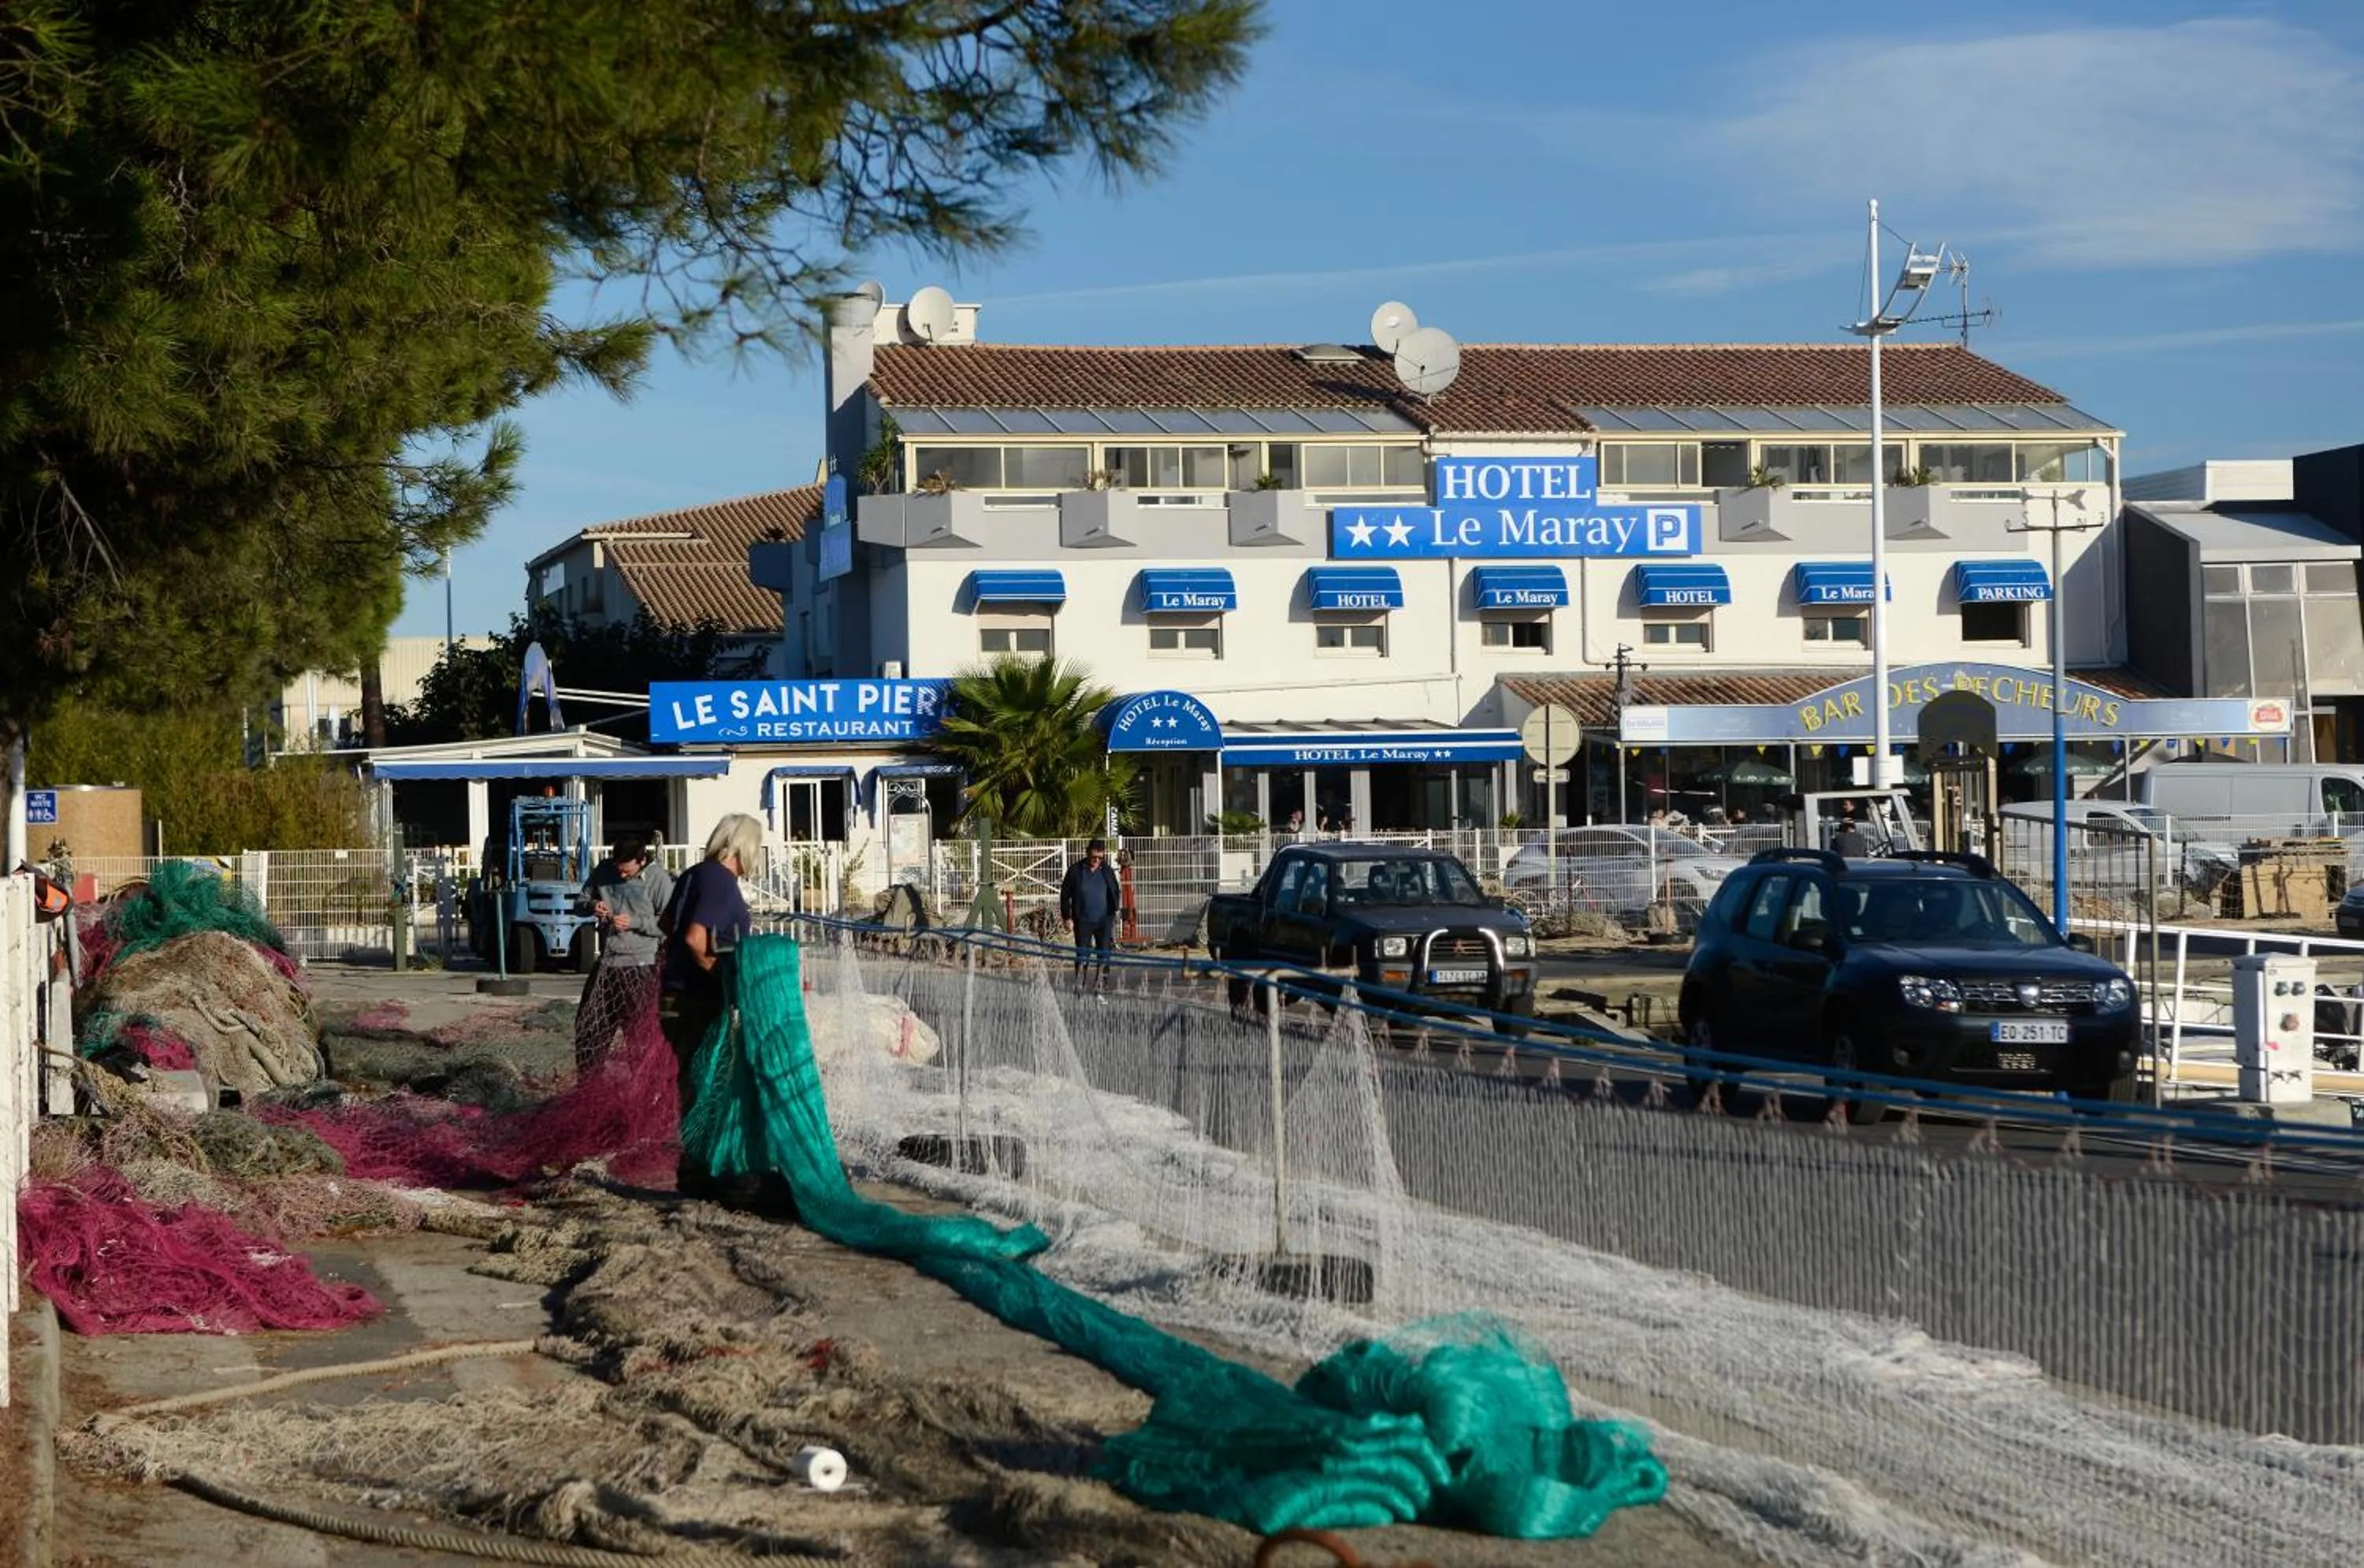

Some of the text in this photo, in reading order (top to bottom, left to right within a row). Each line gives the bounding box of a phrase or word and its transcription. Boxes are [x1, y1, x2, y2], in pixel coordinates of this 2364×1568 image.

[1443, 464, 1591, 500] HOTEL
[1429, 509, 1637, 552] Le Maray
[1655, 514, 1681, 548] P
[1162, 593, 1227, 609] Le Maray
[1337, 593, 1391, 607] HOTEL
[1496, 590, 1558, 606] Le Maray
[1664, 590, 1718, 604] HOTEL
[1820, 585, 1875, 600] Le Mara
[1977, 585, 2046, 600] PARKING
[672, 683, 952, 730] LE SAINT PIER
[1117, 694, 1213, 733] HOTEL Le Maray
[1801, 692, 1864, 732] BAR
[756, 720, 914, 738] RESTAURANT
[1294, 749, 1430, 761] HOTEL Le Maray
